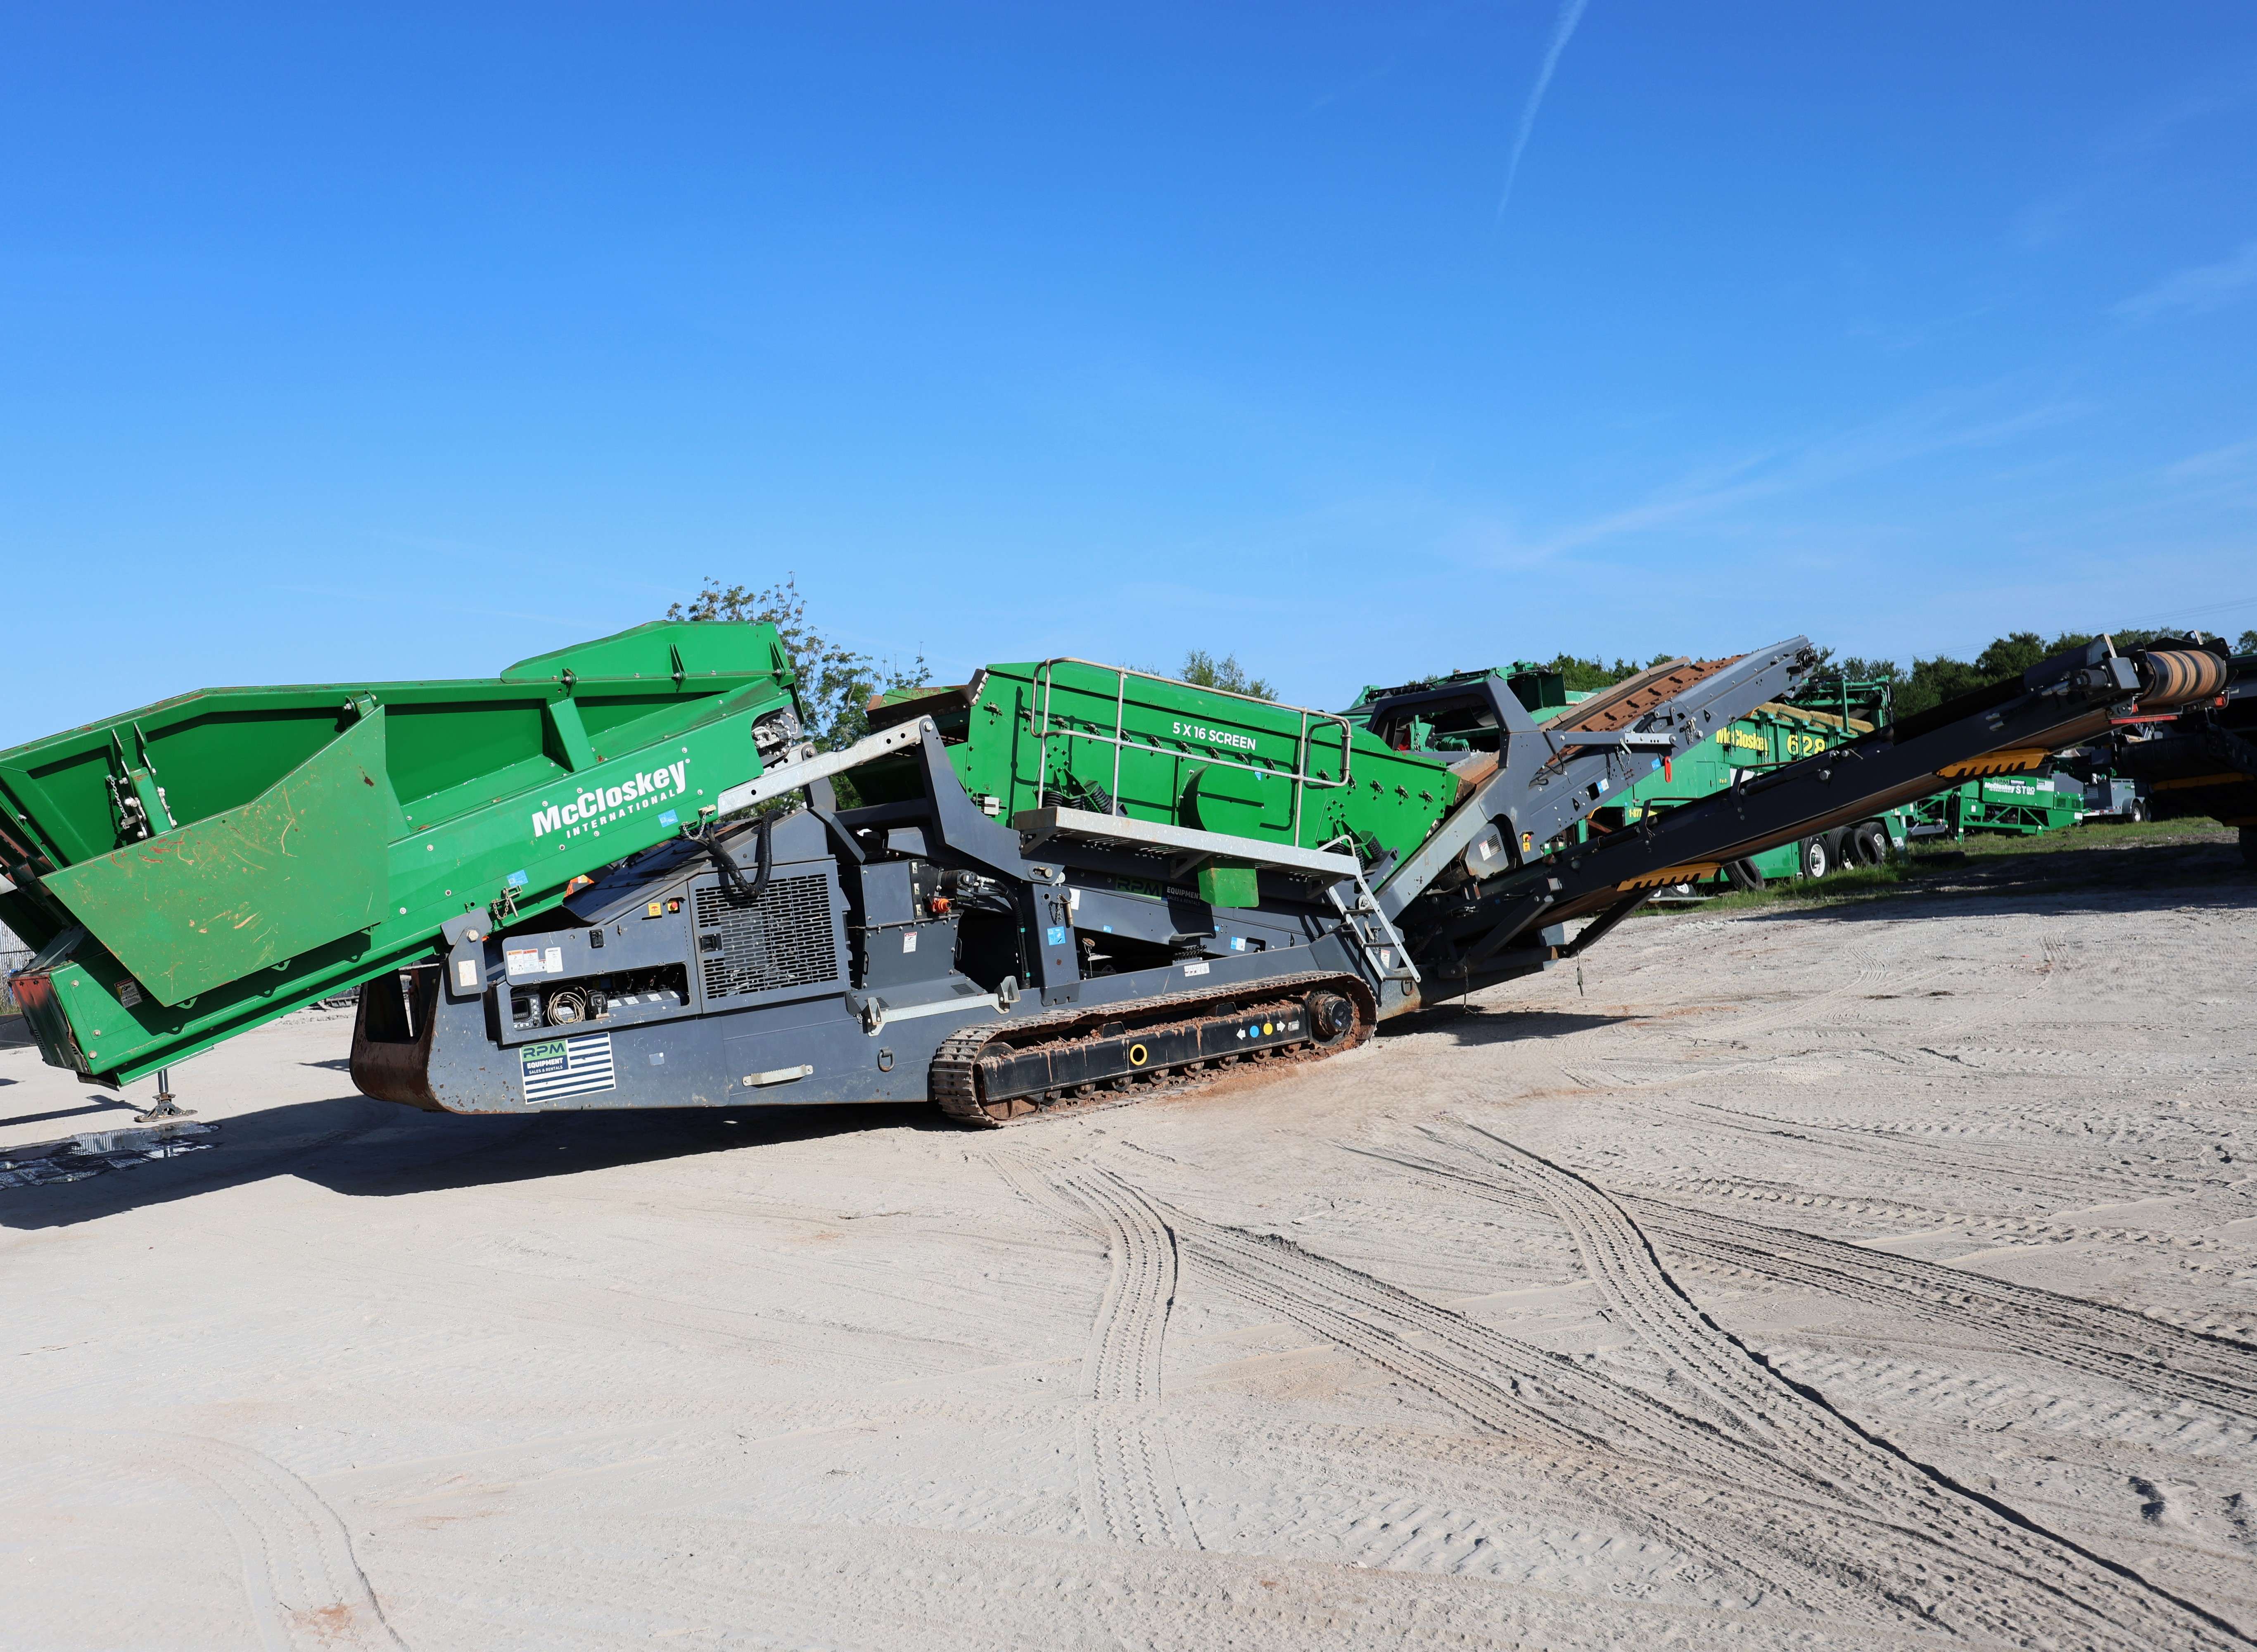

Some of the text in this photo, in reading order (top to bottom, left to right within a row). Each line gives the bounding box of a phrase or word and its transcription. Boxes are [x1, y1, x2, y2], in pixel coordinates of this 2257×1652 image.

[1173, 722, 1256, 750] 5 X 16 SCREEN
[1787, 734, 1826, 757] 628
[532, 760, 686, 837] McCloskey
[566, 789, 675, 838] INTERNATIONAL
[1118, 878, 1160, 897] RPM
[523, 1043, 565, 1058] RPM
[527, 1058, 563, 1069] EQUIPMENT
